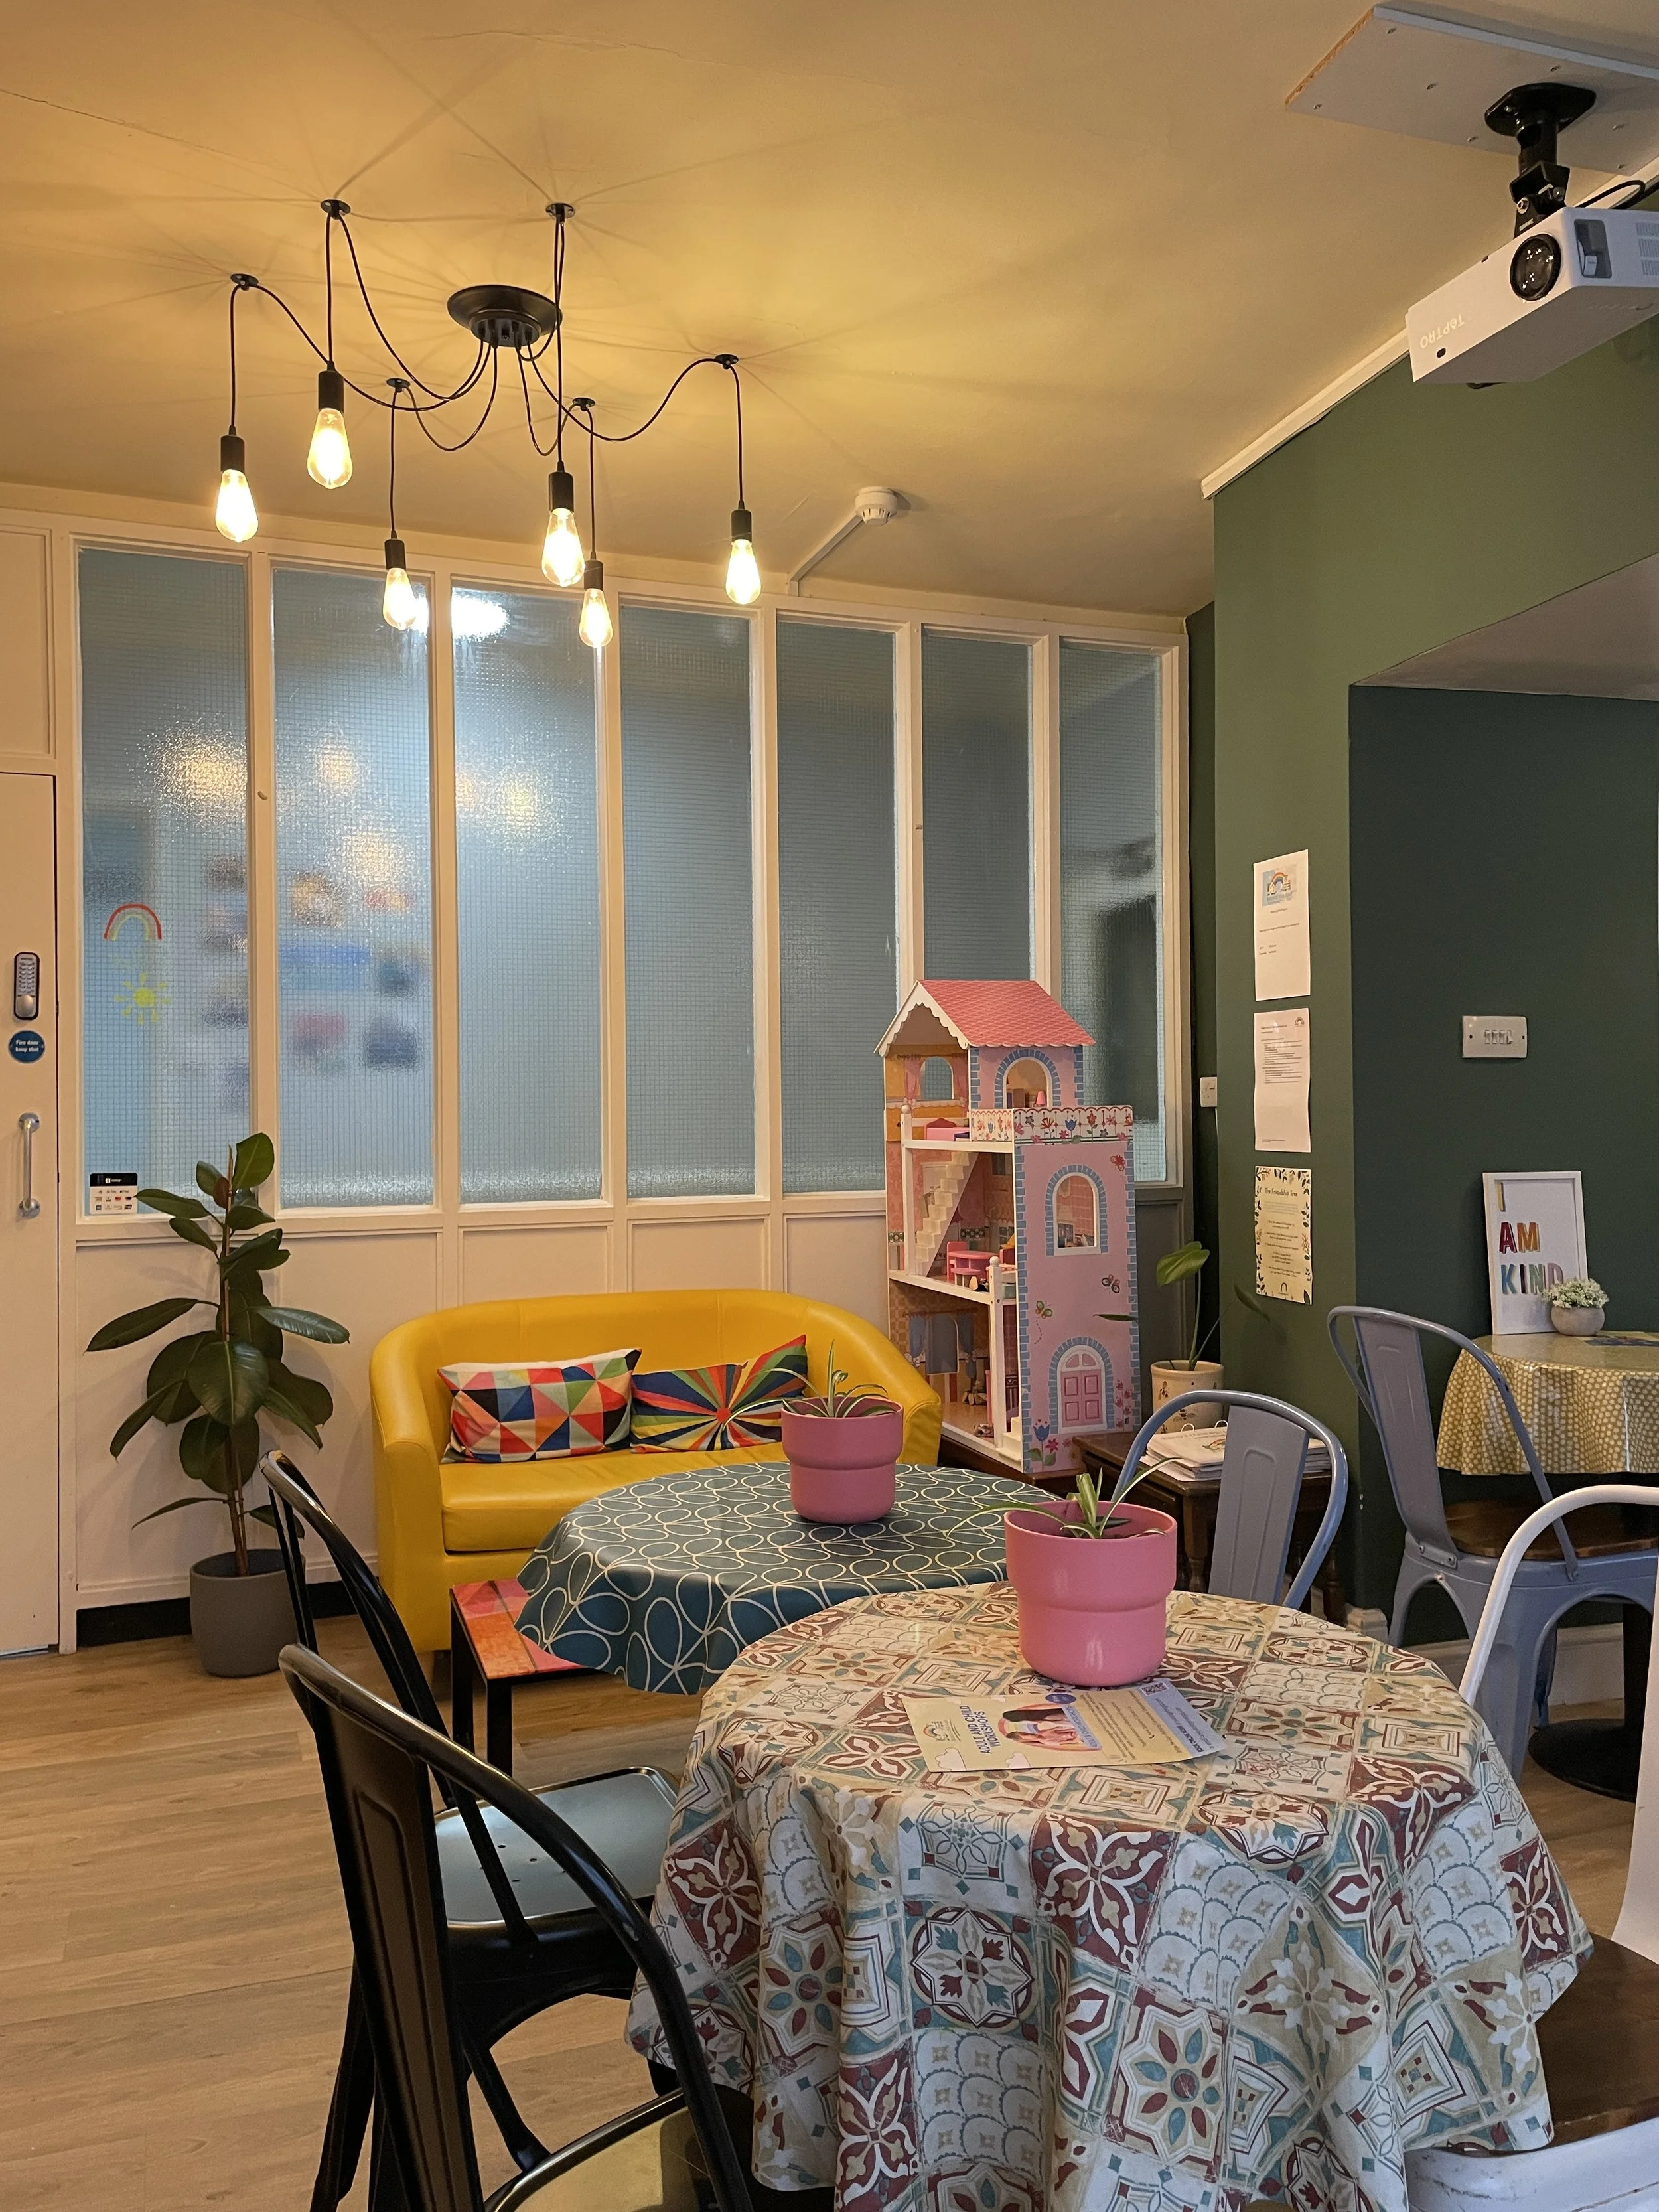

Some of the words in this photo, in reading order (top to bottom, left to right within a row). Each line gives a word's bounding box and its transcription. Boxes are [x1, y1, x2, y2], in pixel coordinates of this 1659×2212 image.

[1420, 313, 1465, 348] TOPTRO
[1496, 1182, 1505, 1212] I
[1499, 1222, 1540, 1254] AM
[1501, 1262, 1564, 1295] KIND
[959, 1706, 975, 1722] CHILD
[967, 1723, 982, 1735] AND
[974, 1711, 1001, 1747] WORKSHOPS
[973, 1736, 992, 1754] ADULT
